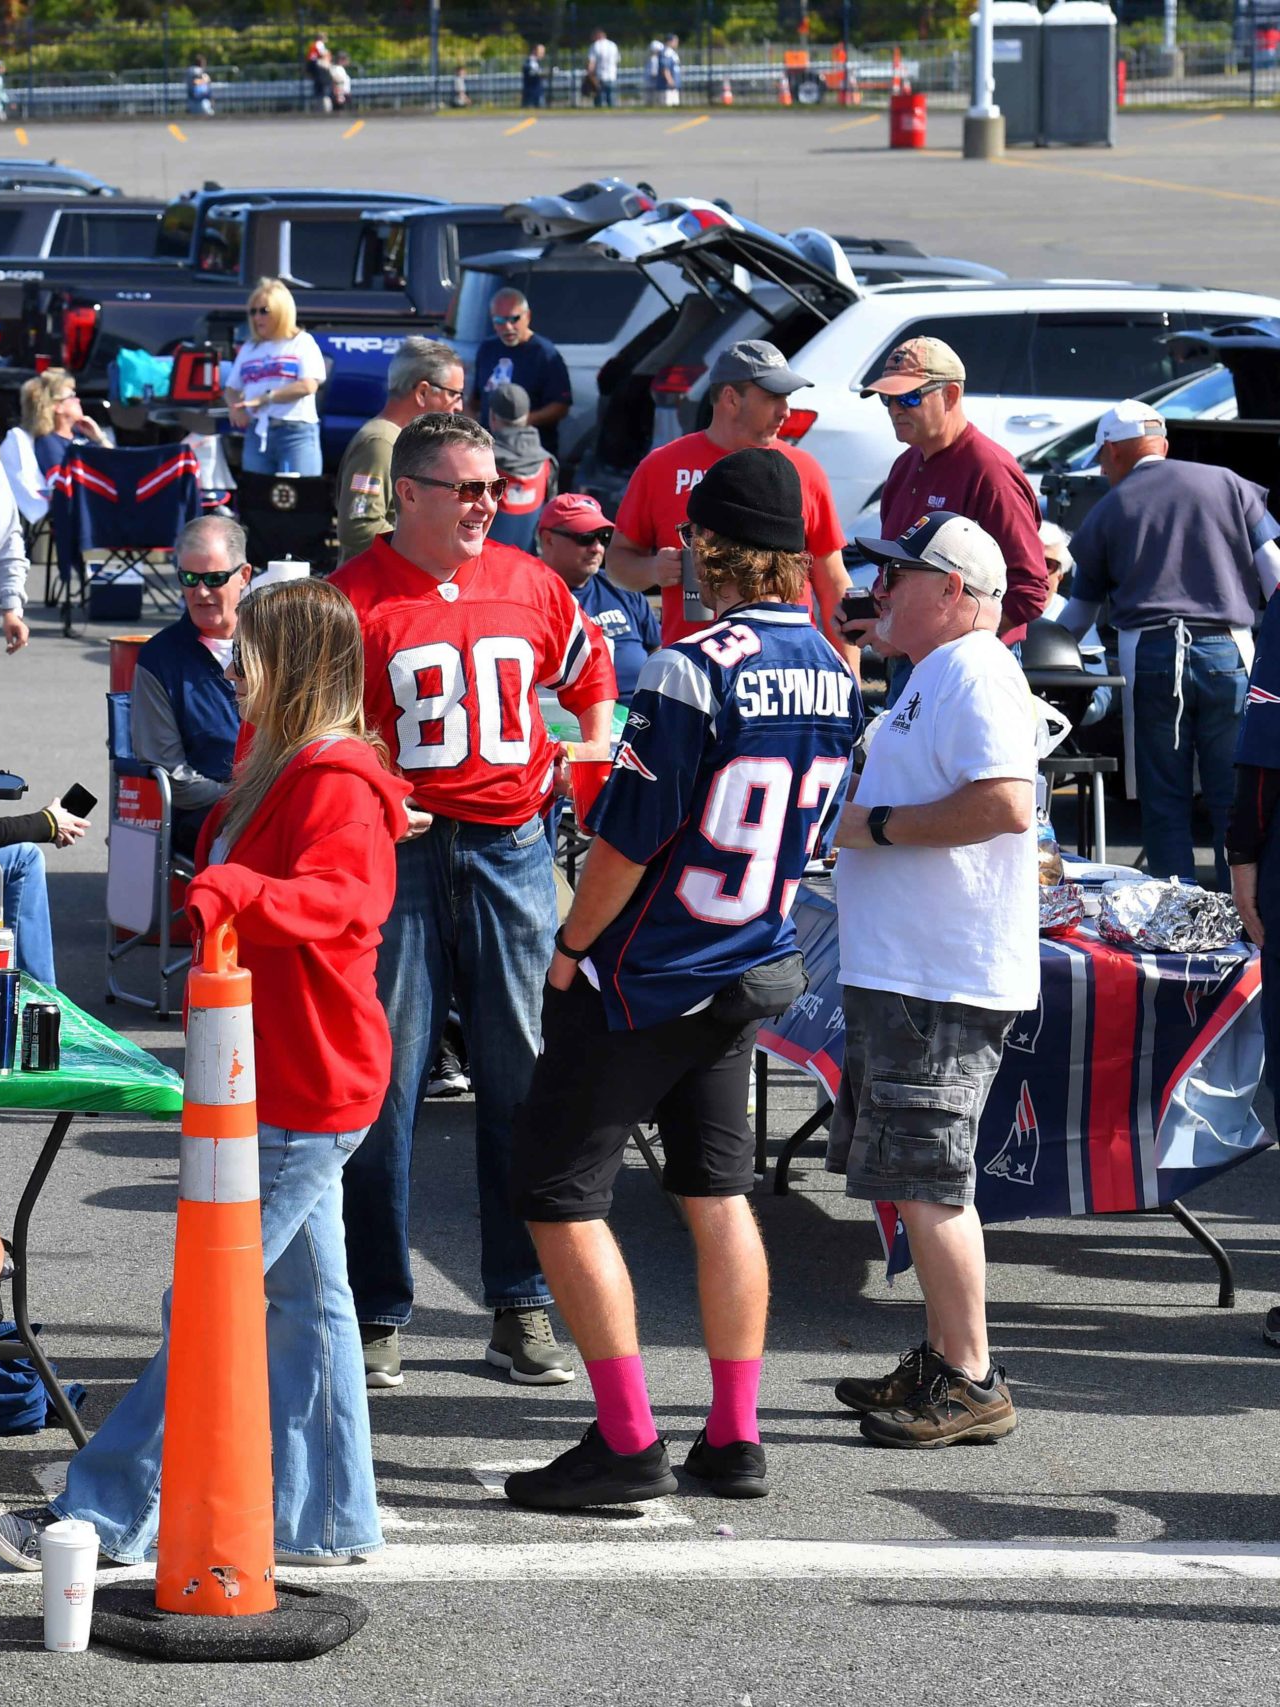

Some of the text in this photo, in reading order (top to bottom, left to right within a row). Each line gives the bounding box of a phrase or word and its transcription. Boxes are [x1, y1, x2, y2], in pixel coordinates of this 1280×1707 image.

[328, 336, 383, 353] TRD
[675, 469, 708, 495] PA
[387, 635, 536, 771] 80
[735, 668, 854, 718] SEYMOU
